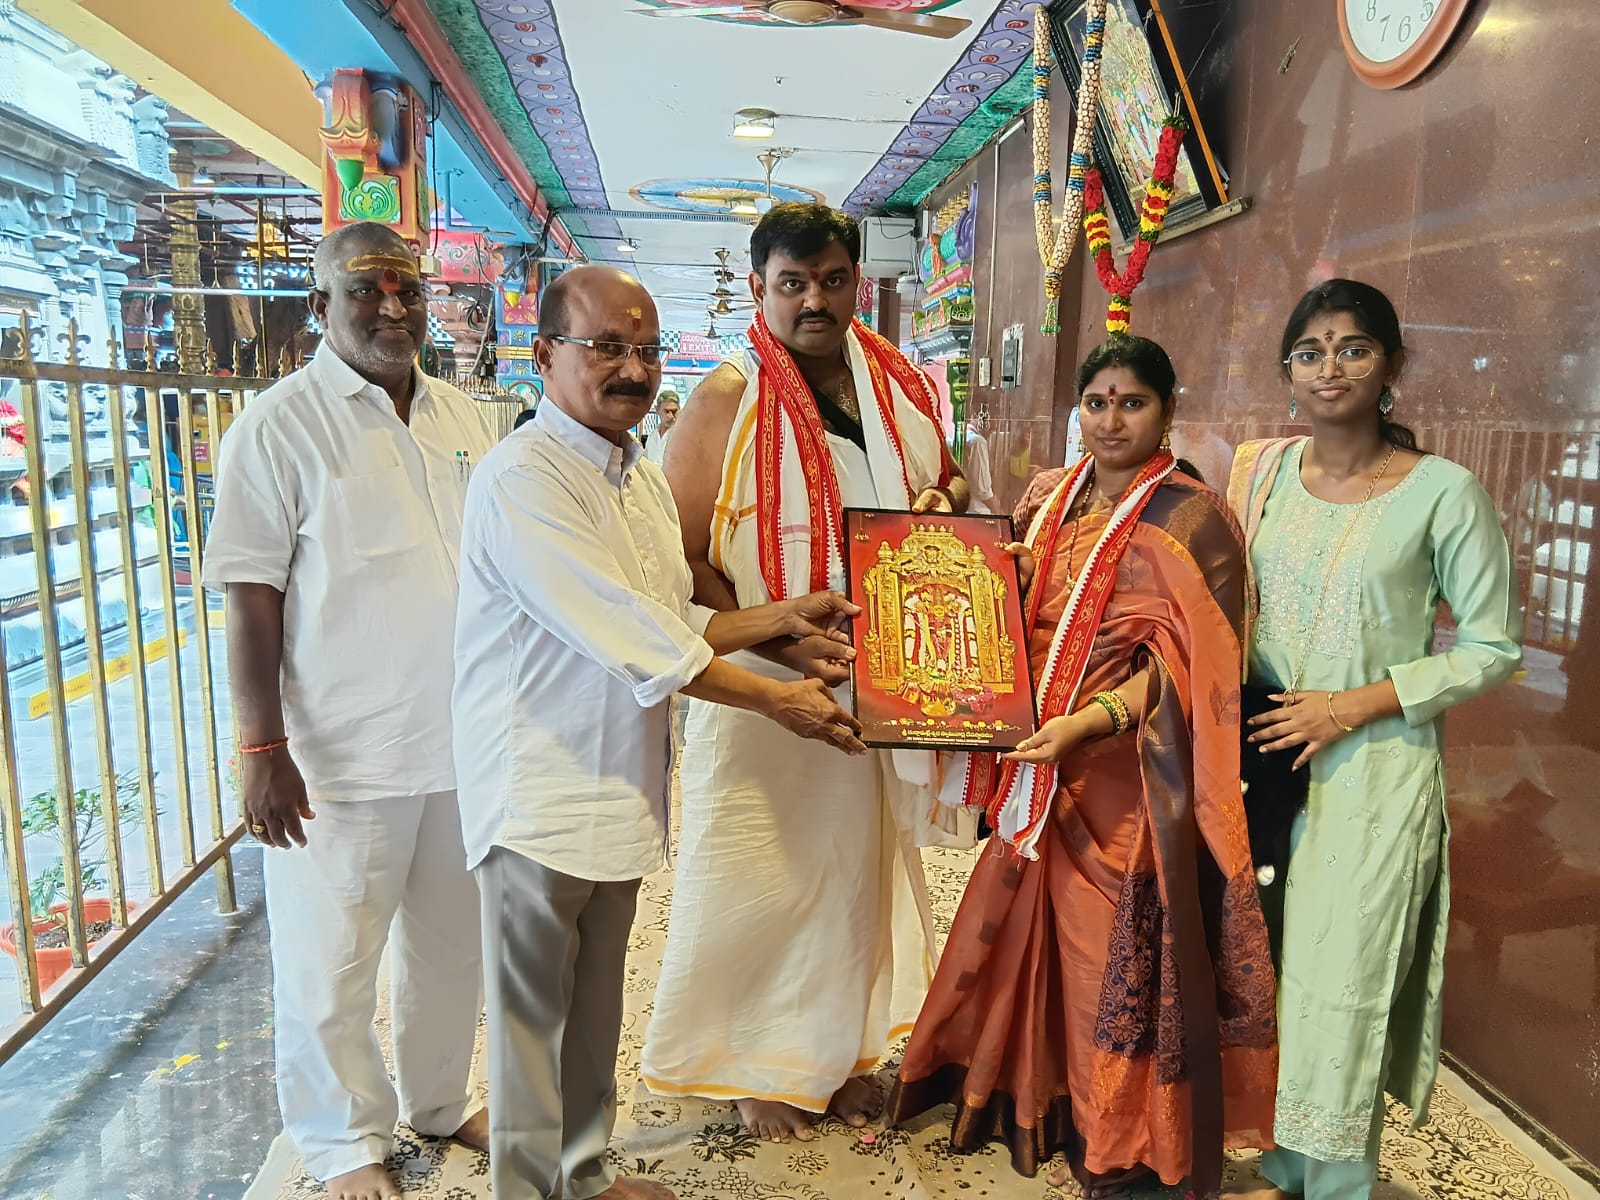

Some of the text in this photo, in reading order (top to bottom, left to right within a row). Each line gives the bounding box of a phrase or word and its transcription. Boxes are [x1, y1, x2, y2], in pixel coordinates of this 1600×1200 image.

[1380, 14, 1391, 42] 7
[1398, 15, 1411, 43] 6
[689, 344, 710, 352] EXIT
